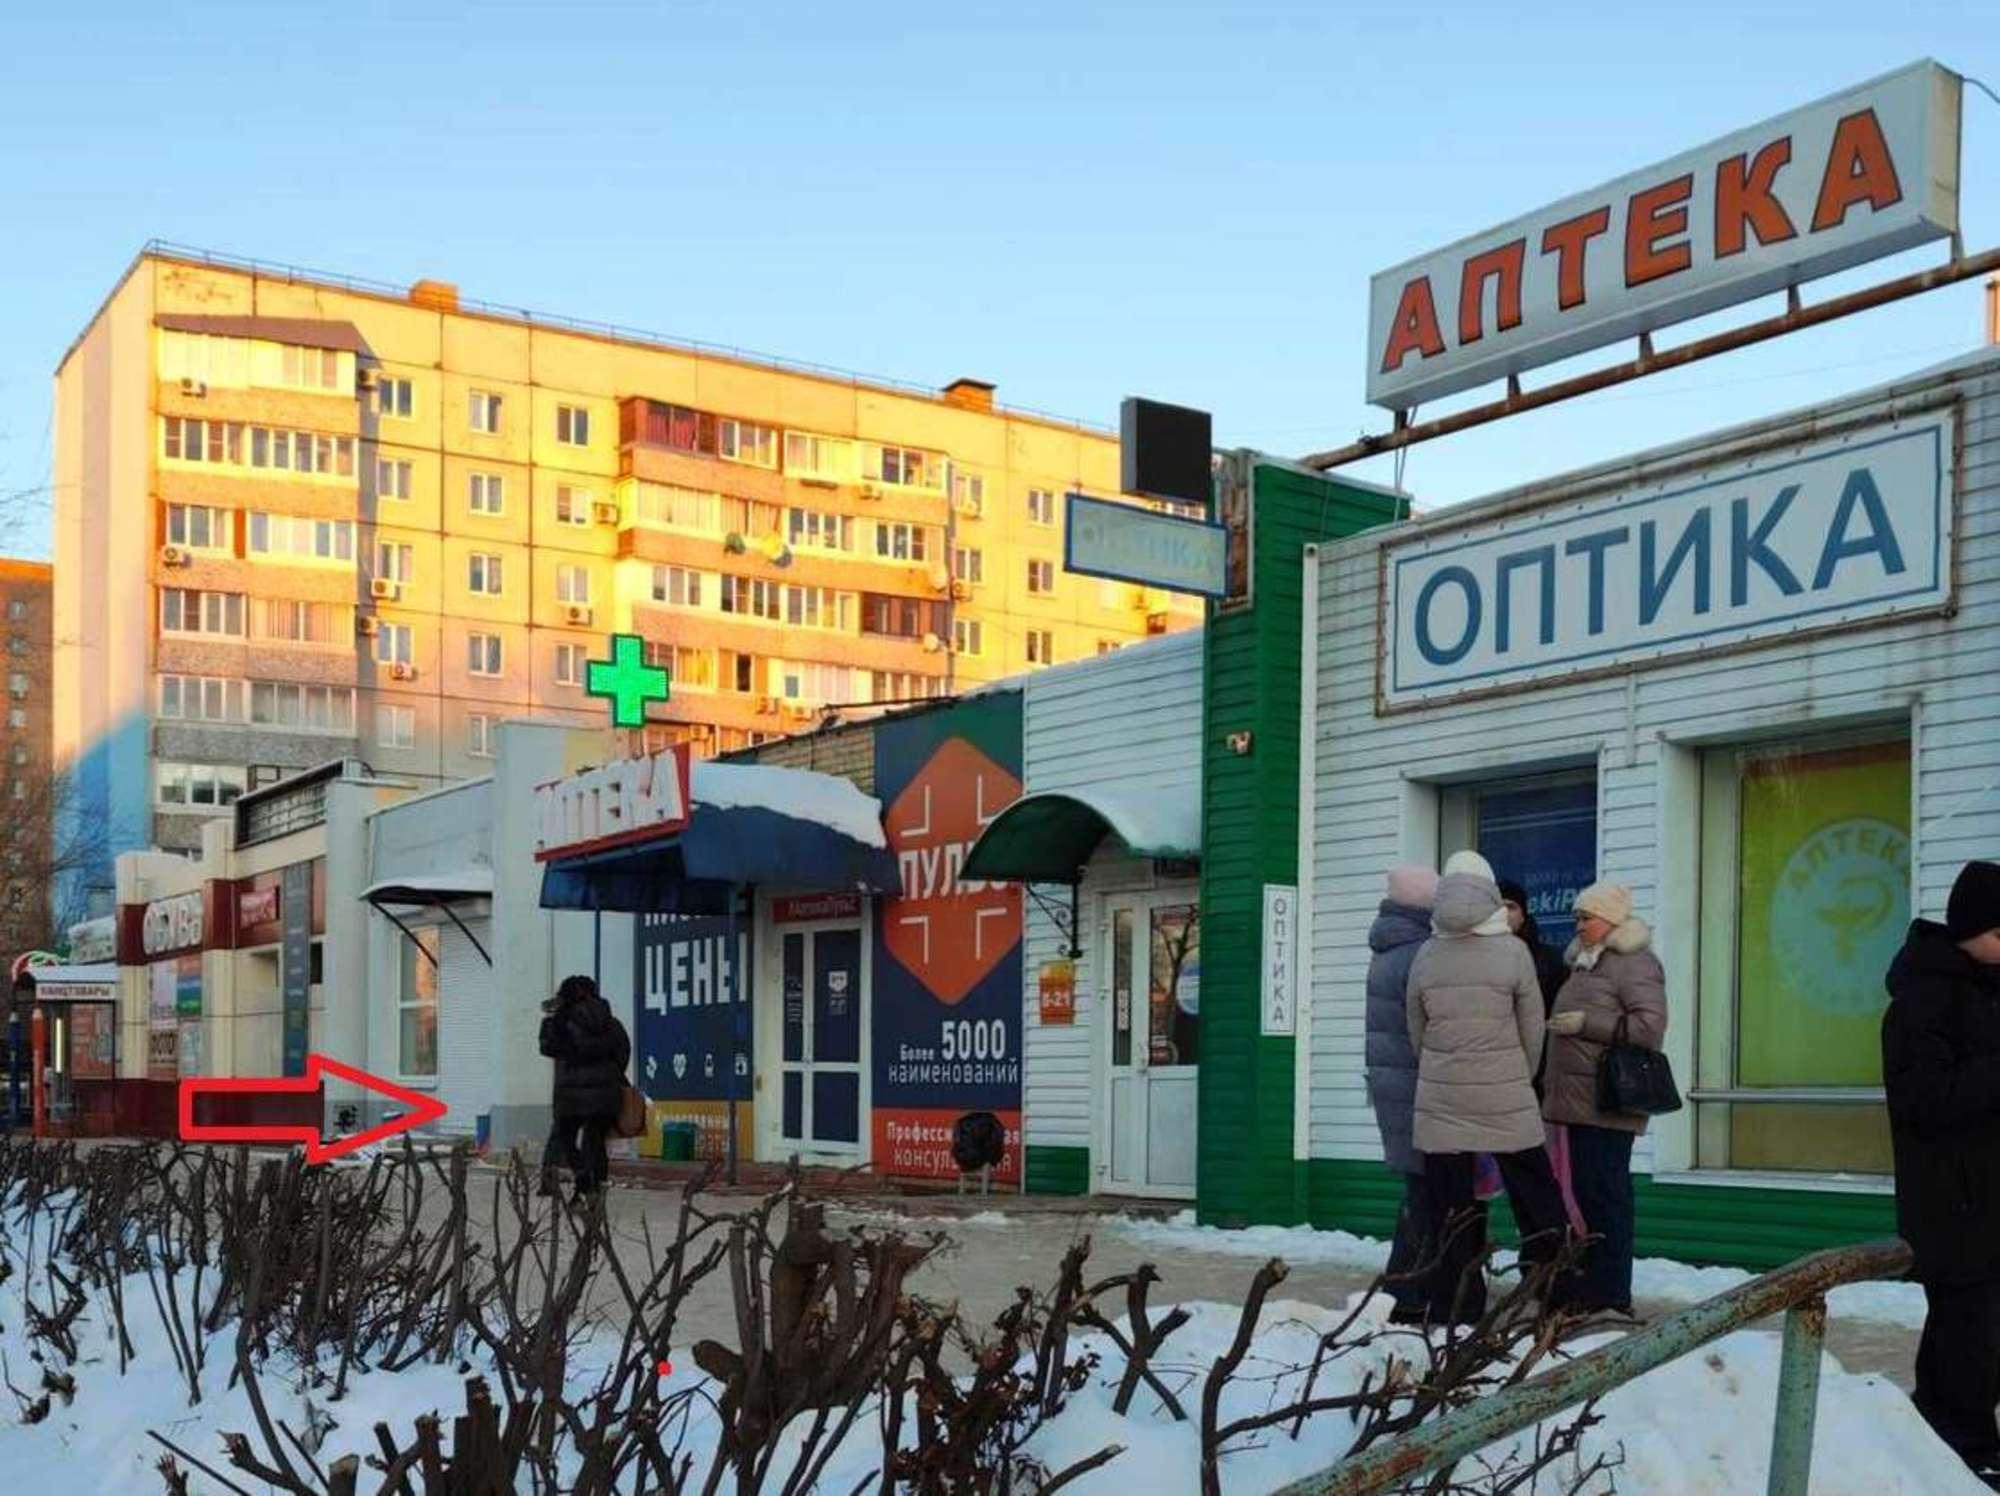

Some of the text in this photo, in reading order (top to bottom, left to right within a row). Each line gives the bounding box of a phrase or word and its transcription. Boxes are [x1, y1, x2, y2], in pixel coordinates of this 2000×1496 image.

[1380, 106, 1903, 374] АПТЕКА
[1414, 468, 1906, 666] ОПТИКА
[898, 843, 1007, 902] ПУЛ
[644, 931, 748, 1017] ЦЕНЫ
[1272, 897, 1288, 1022] ОПТИКА
[888, 1057, 1019, 1084] наименований
[900, 1019, 1006, 1061] Более 5000
